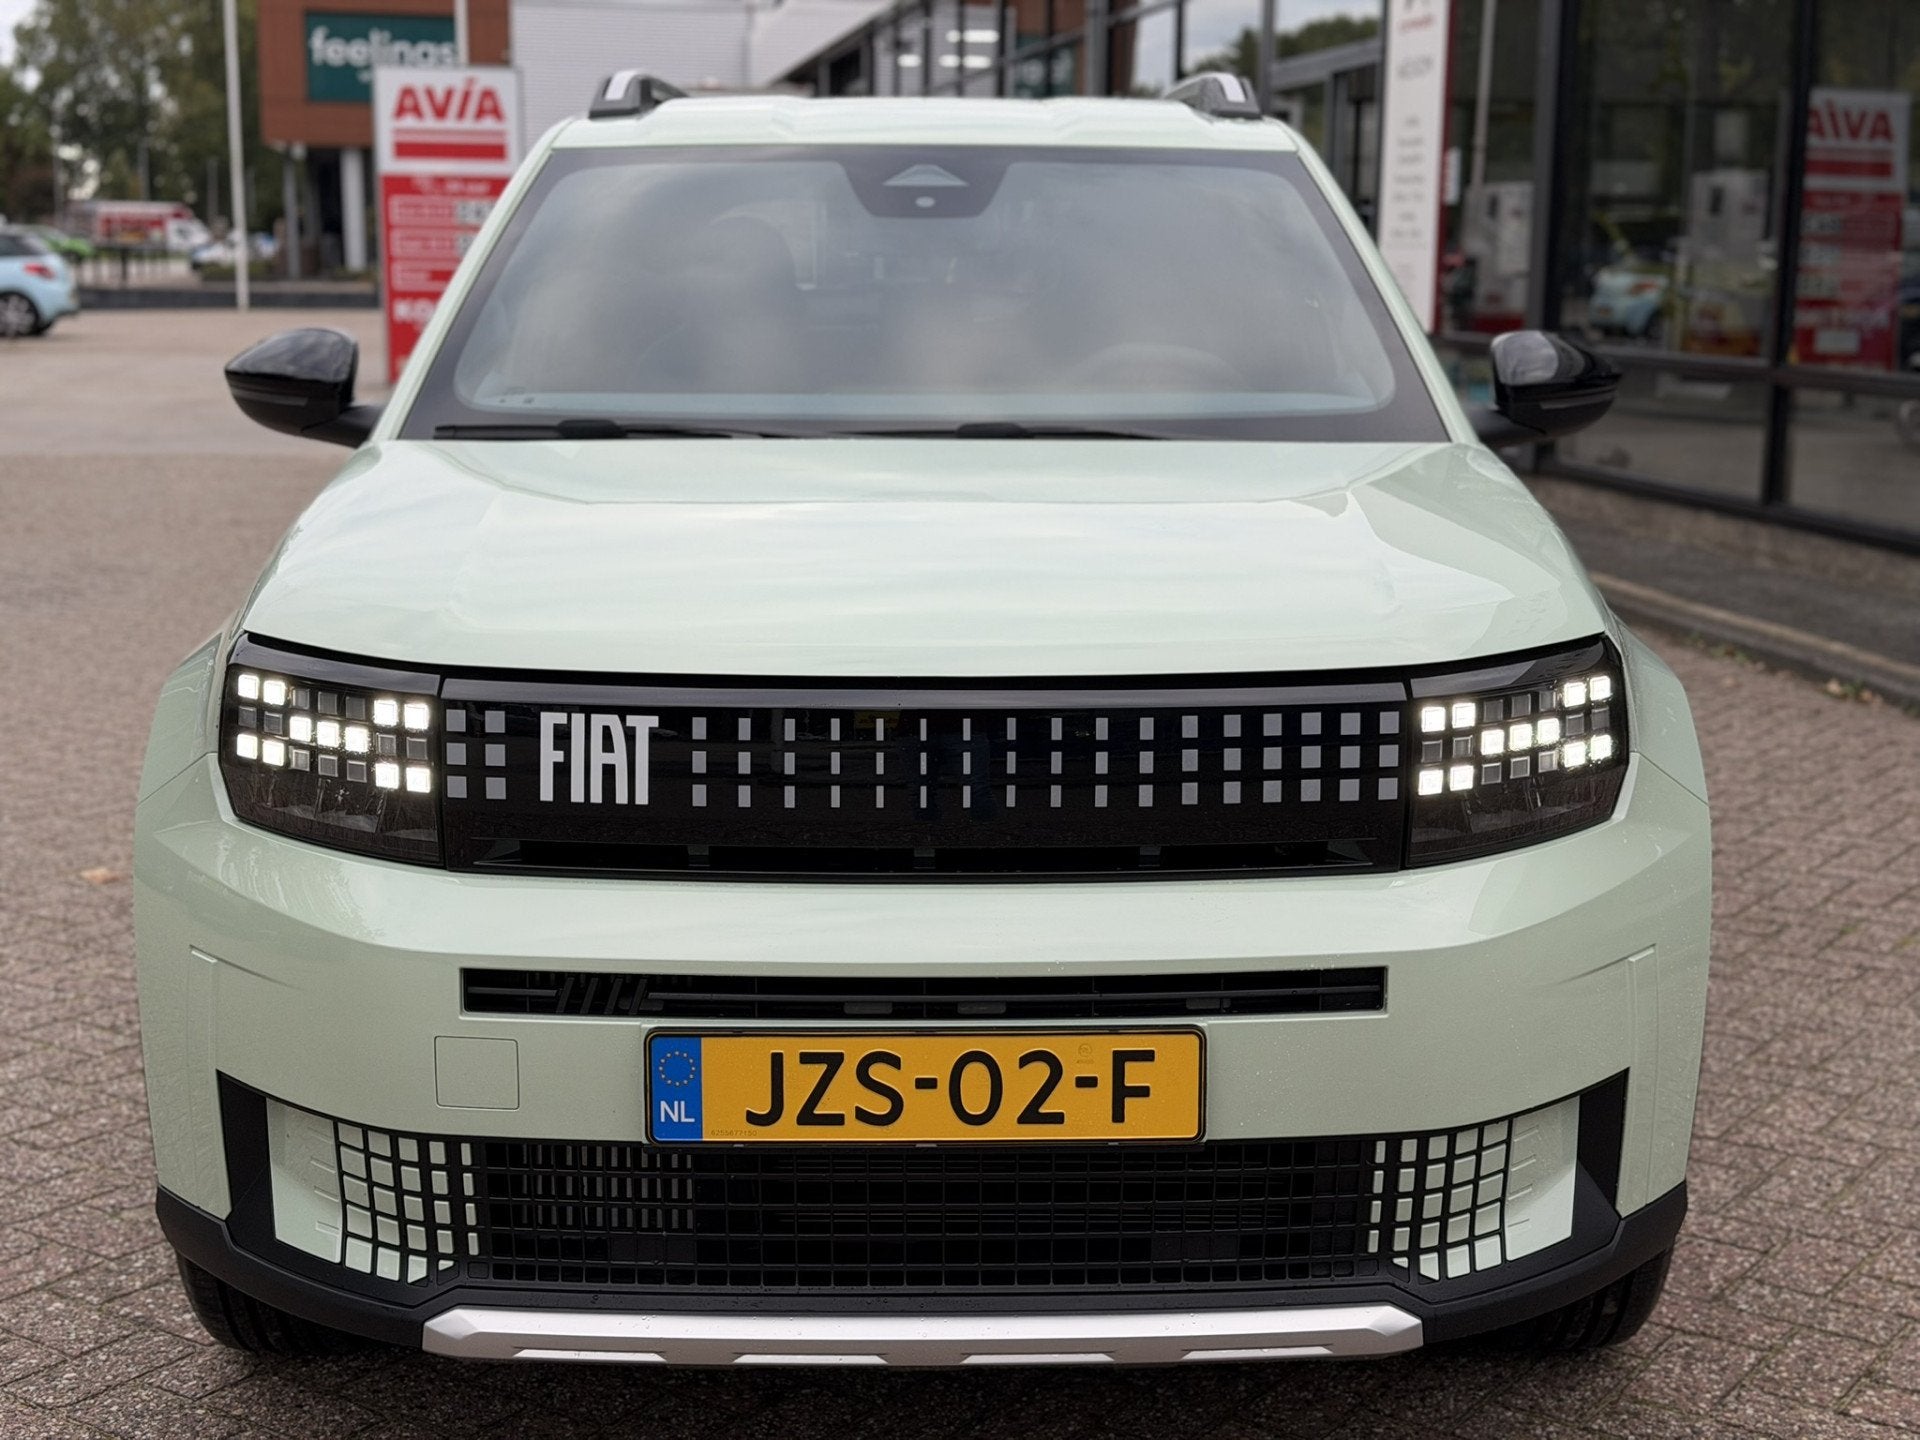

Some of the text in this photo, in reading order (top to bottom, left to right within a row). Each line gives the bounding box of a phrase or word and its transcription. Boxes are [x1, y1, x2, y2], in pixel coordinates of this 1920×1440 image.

[540, 711, 659, 805] FIAT
[659, 1101, 695, 1123] NL
[745, 1049, 1156, 1127] JZS-02-F
